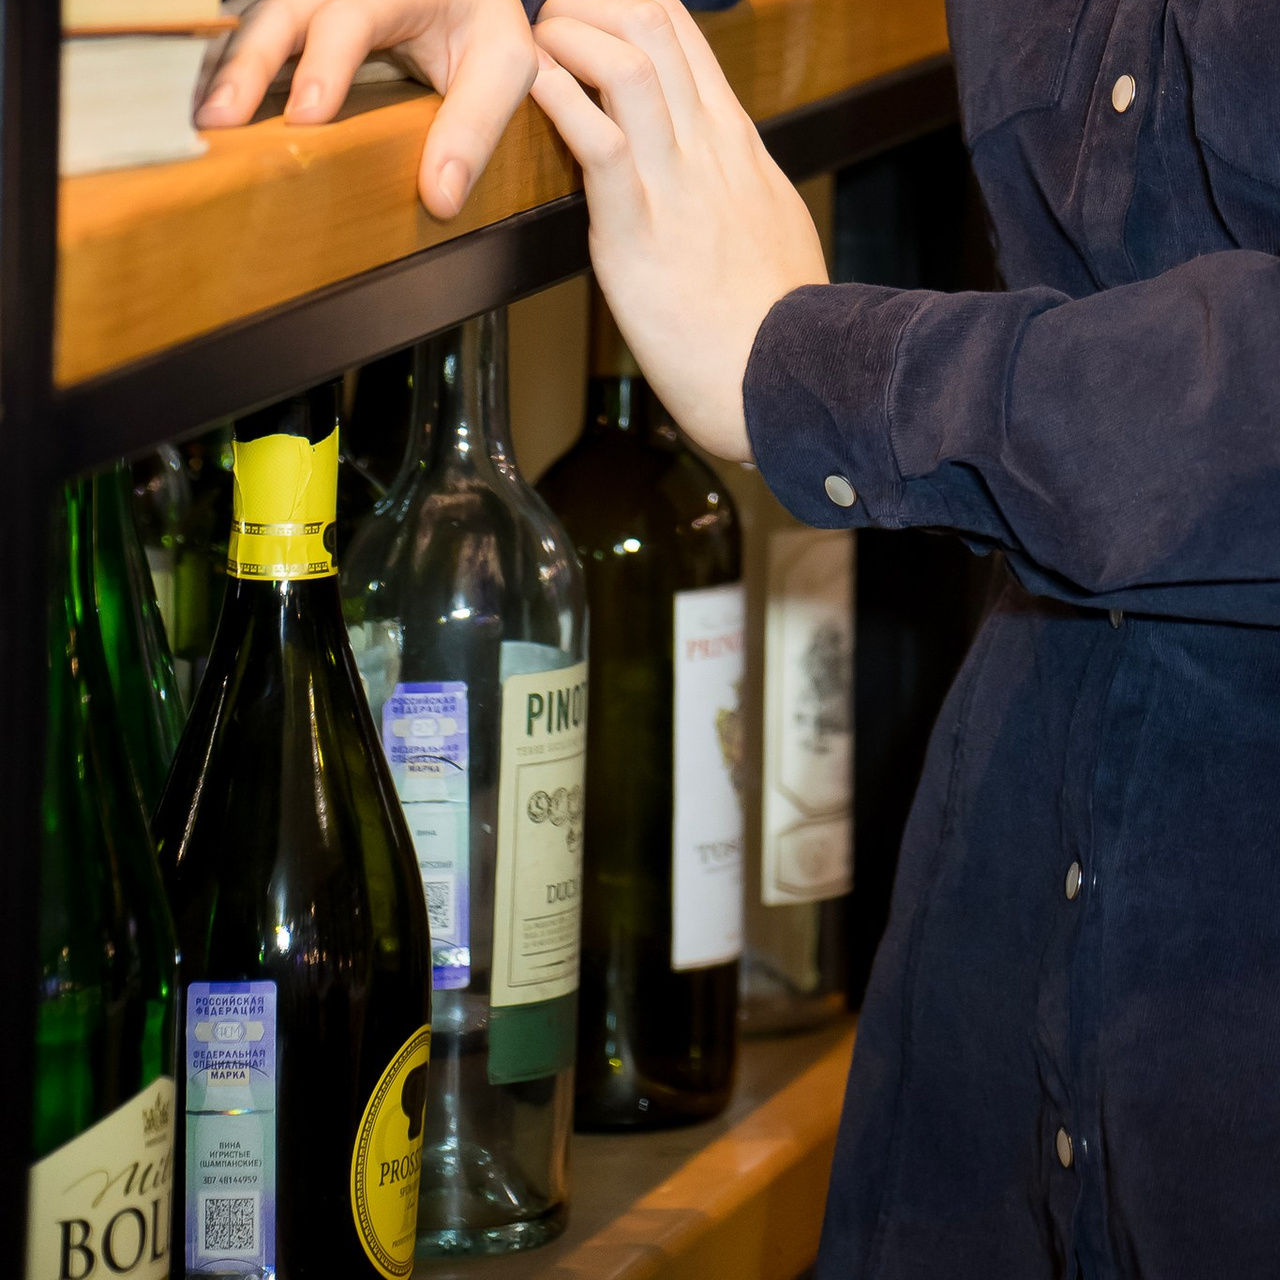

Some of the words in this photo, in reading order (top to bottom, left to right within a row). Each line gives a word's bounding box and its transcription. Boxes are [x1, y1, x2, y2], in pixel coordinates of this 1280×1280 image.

[195, 995, 265, 1006] РОССИЙСКАЯ
[195, 1006, 265, 1016] ФЕДЕРАЦИЯ
[193, 1049, 266, 1060] ФЕДЕРАЛЬНАЯ
[193, 1059, 266, 1071] СПЕЦИАЛЬНАЯ
[210, 1071, 246, 1080] МАРКА
[219, 1141, 241, 1150] ВИНА
[209, 1150, 251, 1159] ИГРИСТЫЕ
[199, 1159, 263, 1169] (ШАМПАНСКИЕ)
[379, 1144, 422, 1188] PROSS
[202, 1176, 217, 1185] 307
[57, 1198, 168, 1280] BOL
